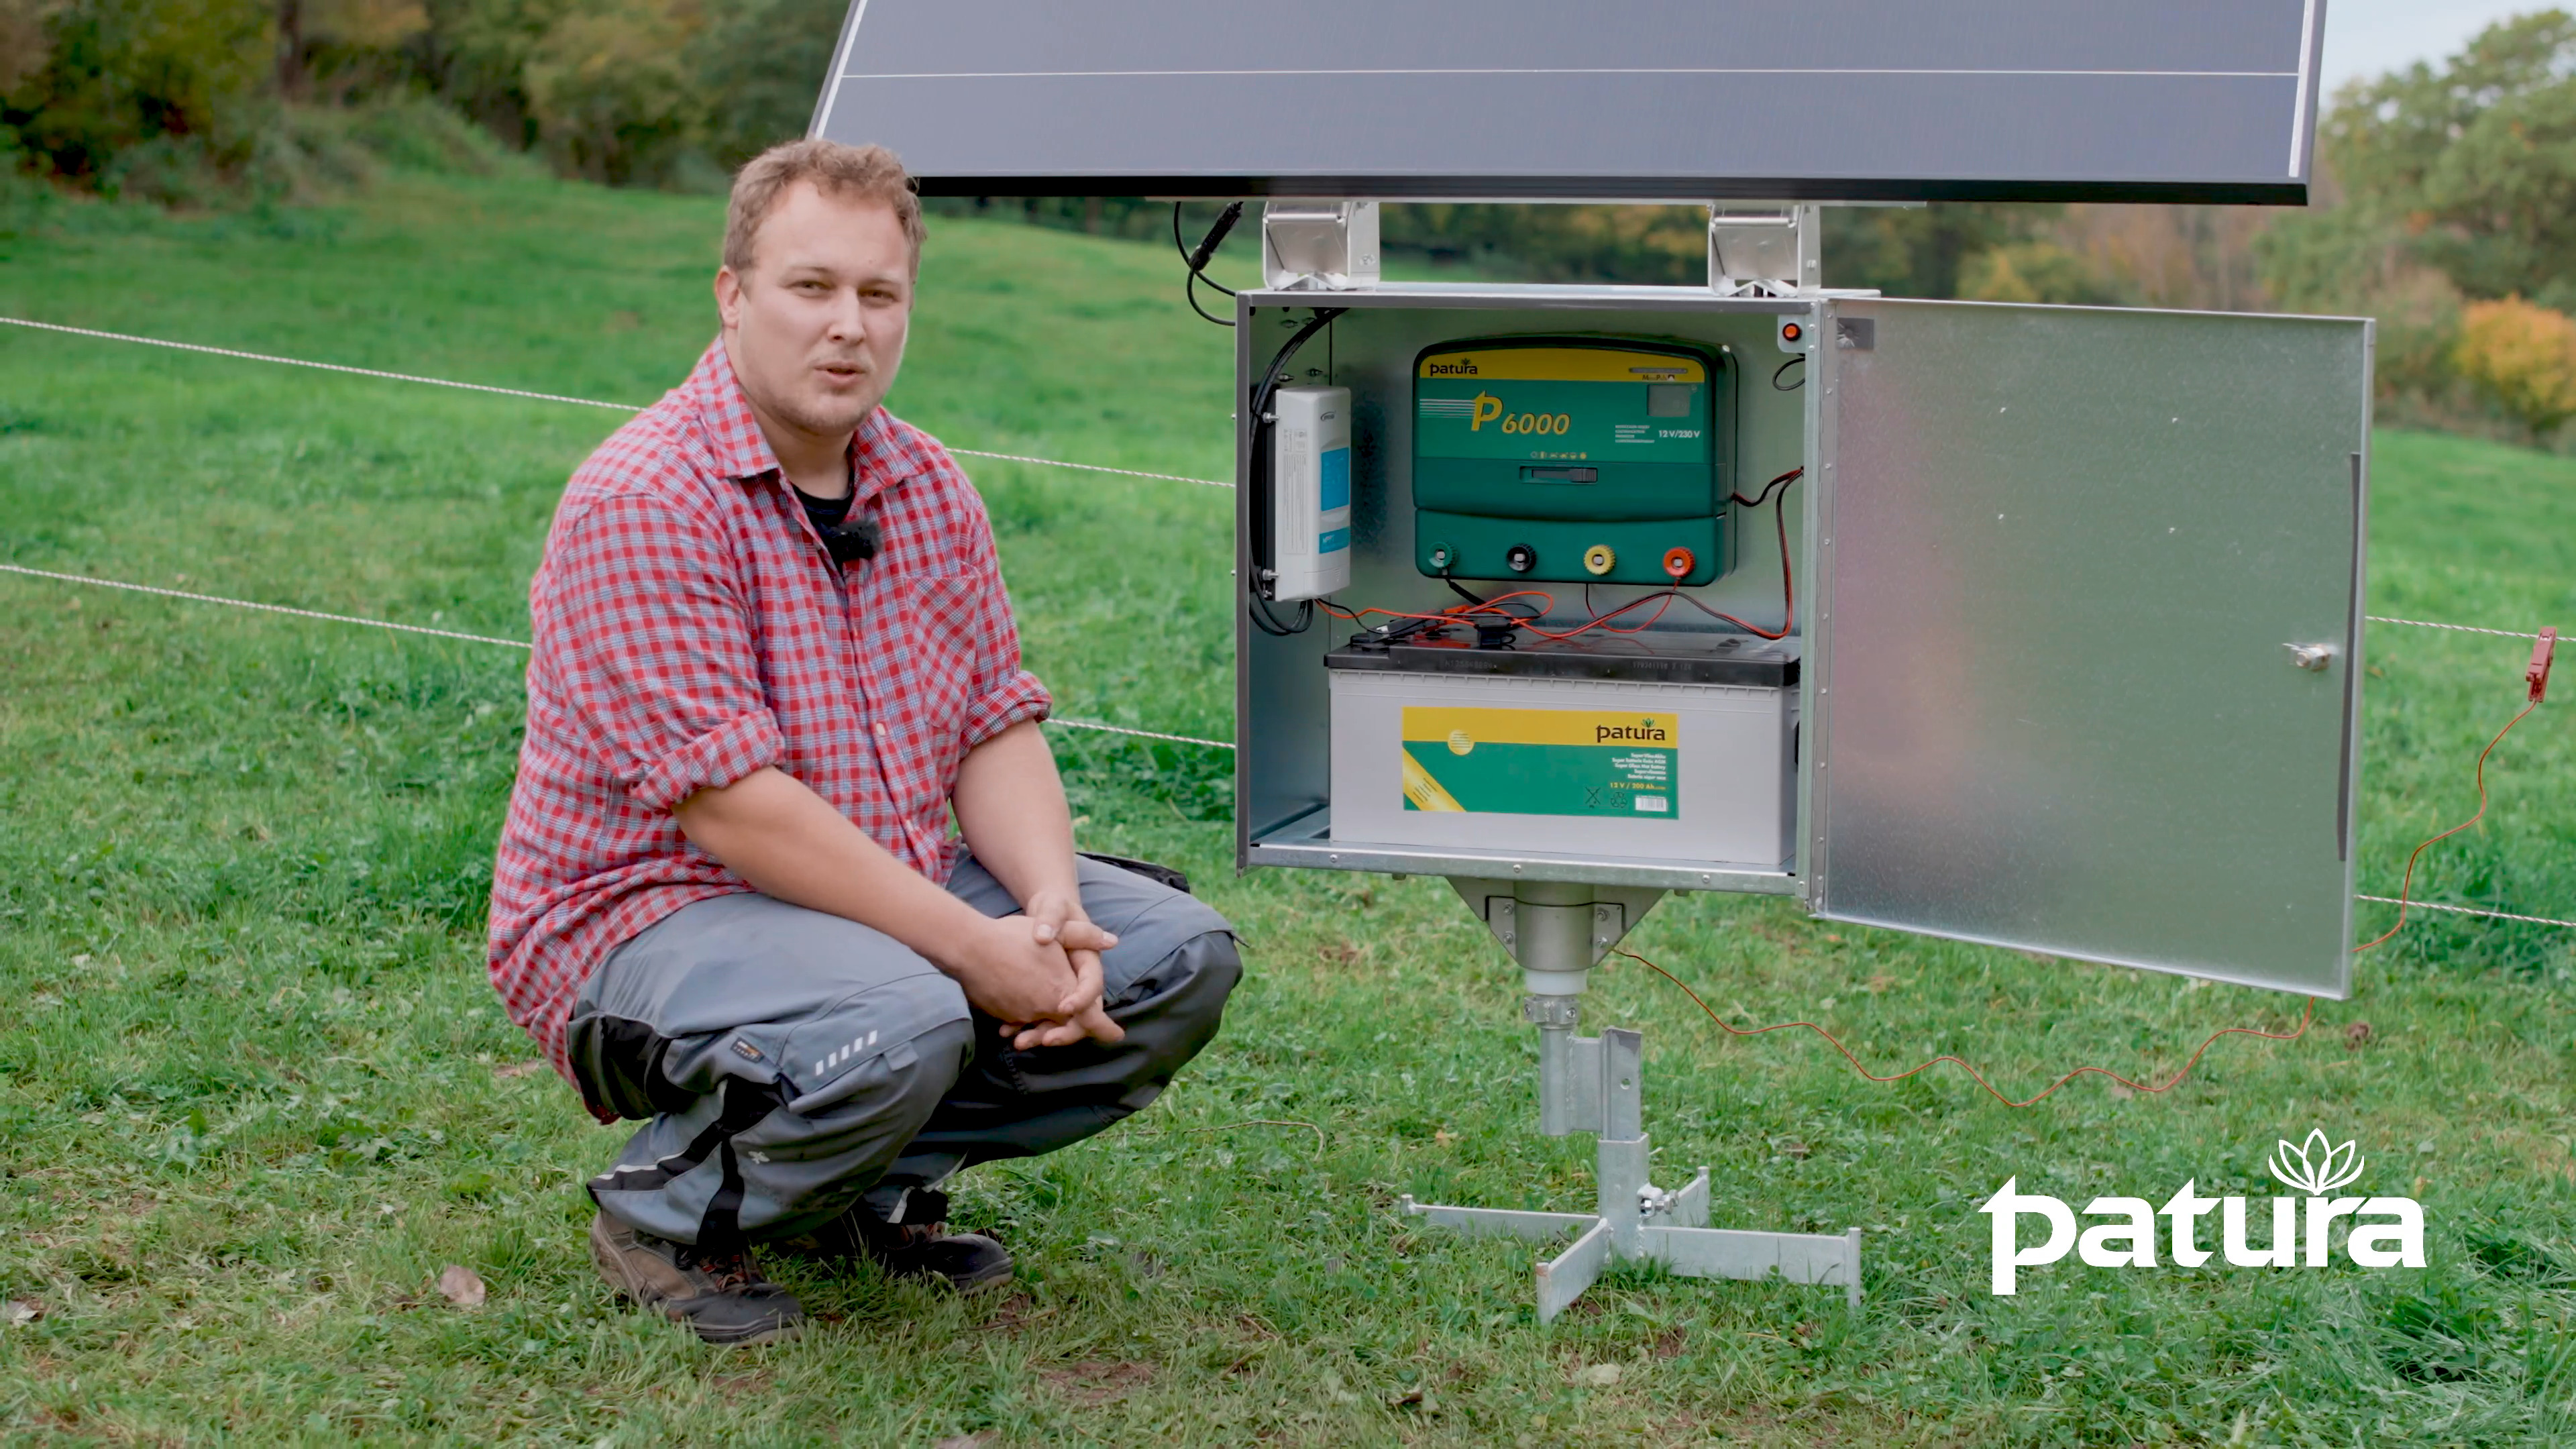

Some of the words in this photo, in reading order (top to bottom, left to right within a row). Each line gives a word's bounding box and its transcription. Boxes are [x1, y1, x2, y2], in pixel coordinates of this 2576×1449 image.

[1430, 363, 1478, 376] patura
[1502, 413, 1571, 435] 6000
[1658, 430, 1668, 438] 12
[1595, 724, 1666, 743] patura
